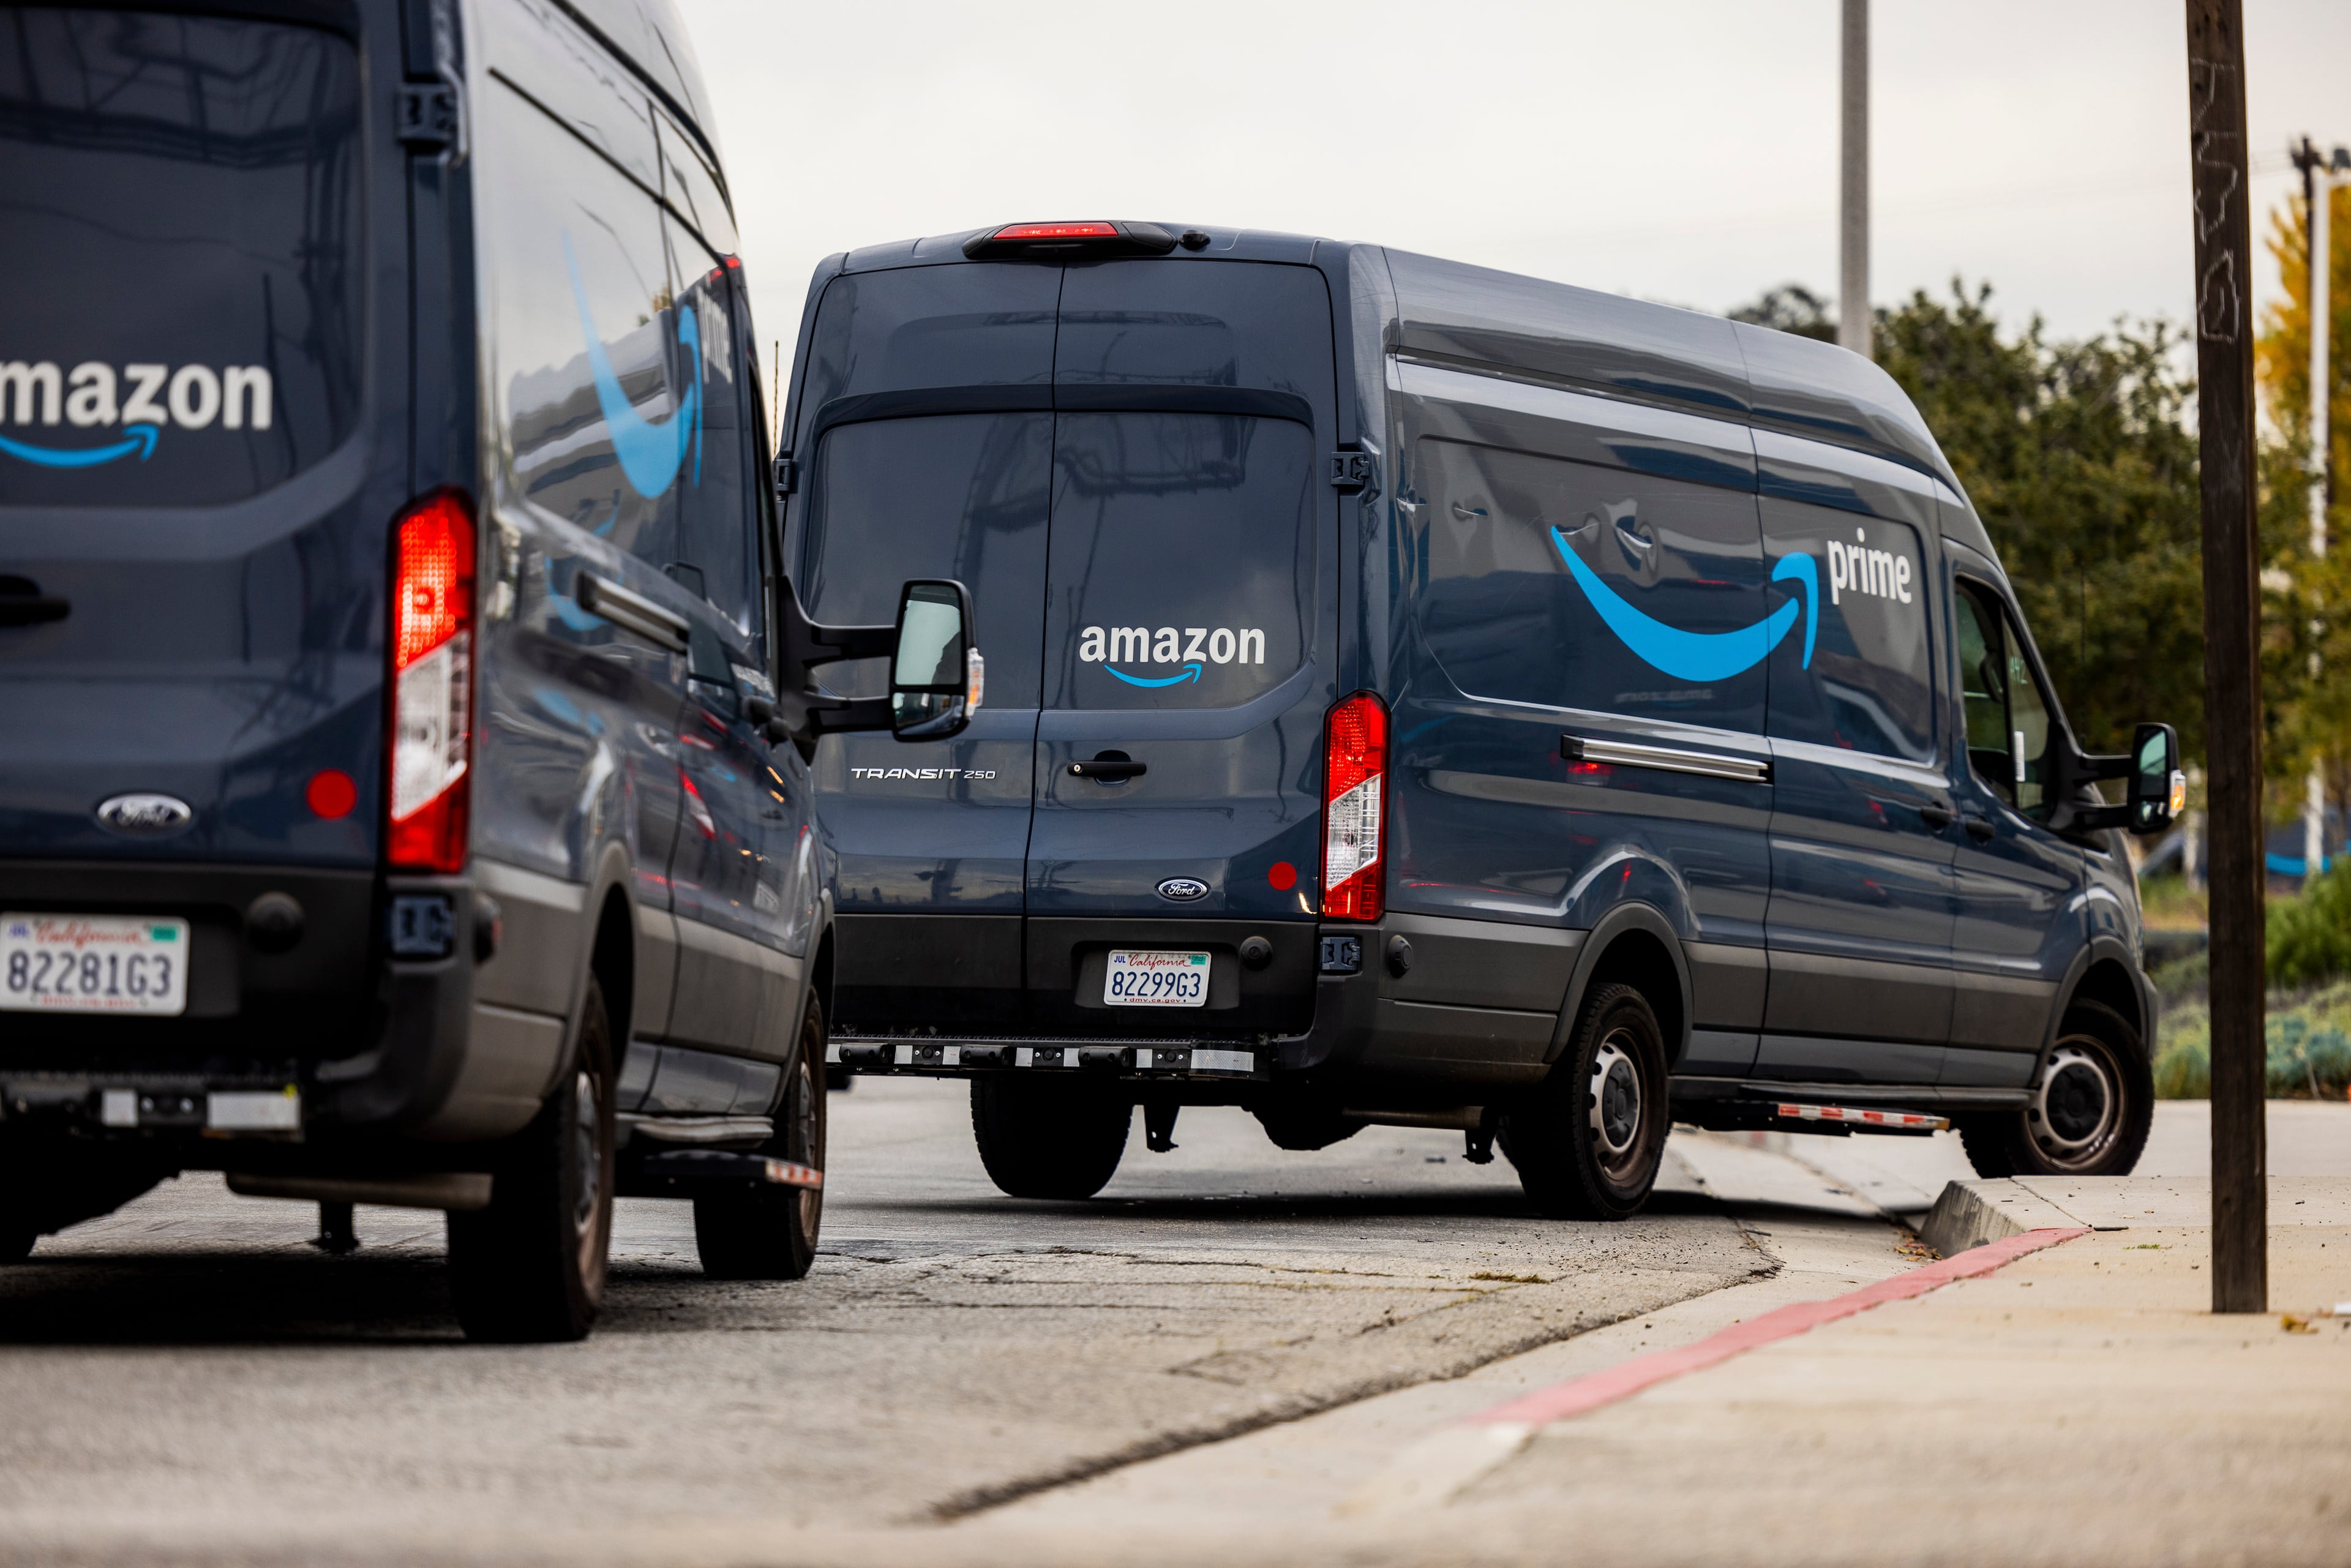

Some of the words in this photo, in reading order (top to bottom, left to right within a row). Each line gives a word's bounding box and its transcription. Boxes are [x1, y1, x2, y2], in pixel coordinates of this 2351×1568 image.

[1827, 527, 1912, 606] prime
[1079, 626, 1265, 664] amazon
[850, 768, 962, 779] TRANSIT
[963, 770, 997, 779] 250
[1168, 882, 1196, 895] Ford
[1114, 955, 1126, 964] JUL
[1129, 954, 1191, 970] California
[7, 950, 172, 998] 82281G3
[1112, 971, 1201, 997] 82299G3
